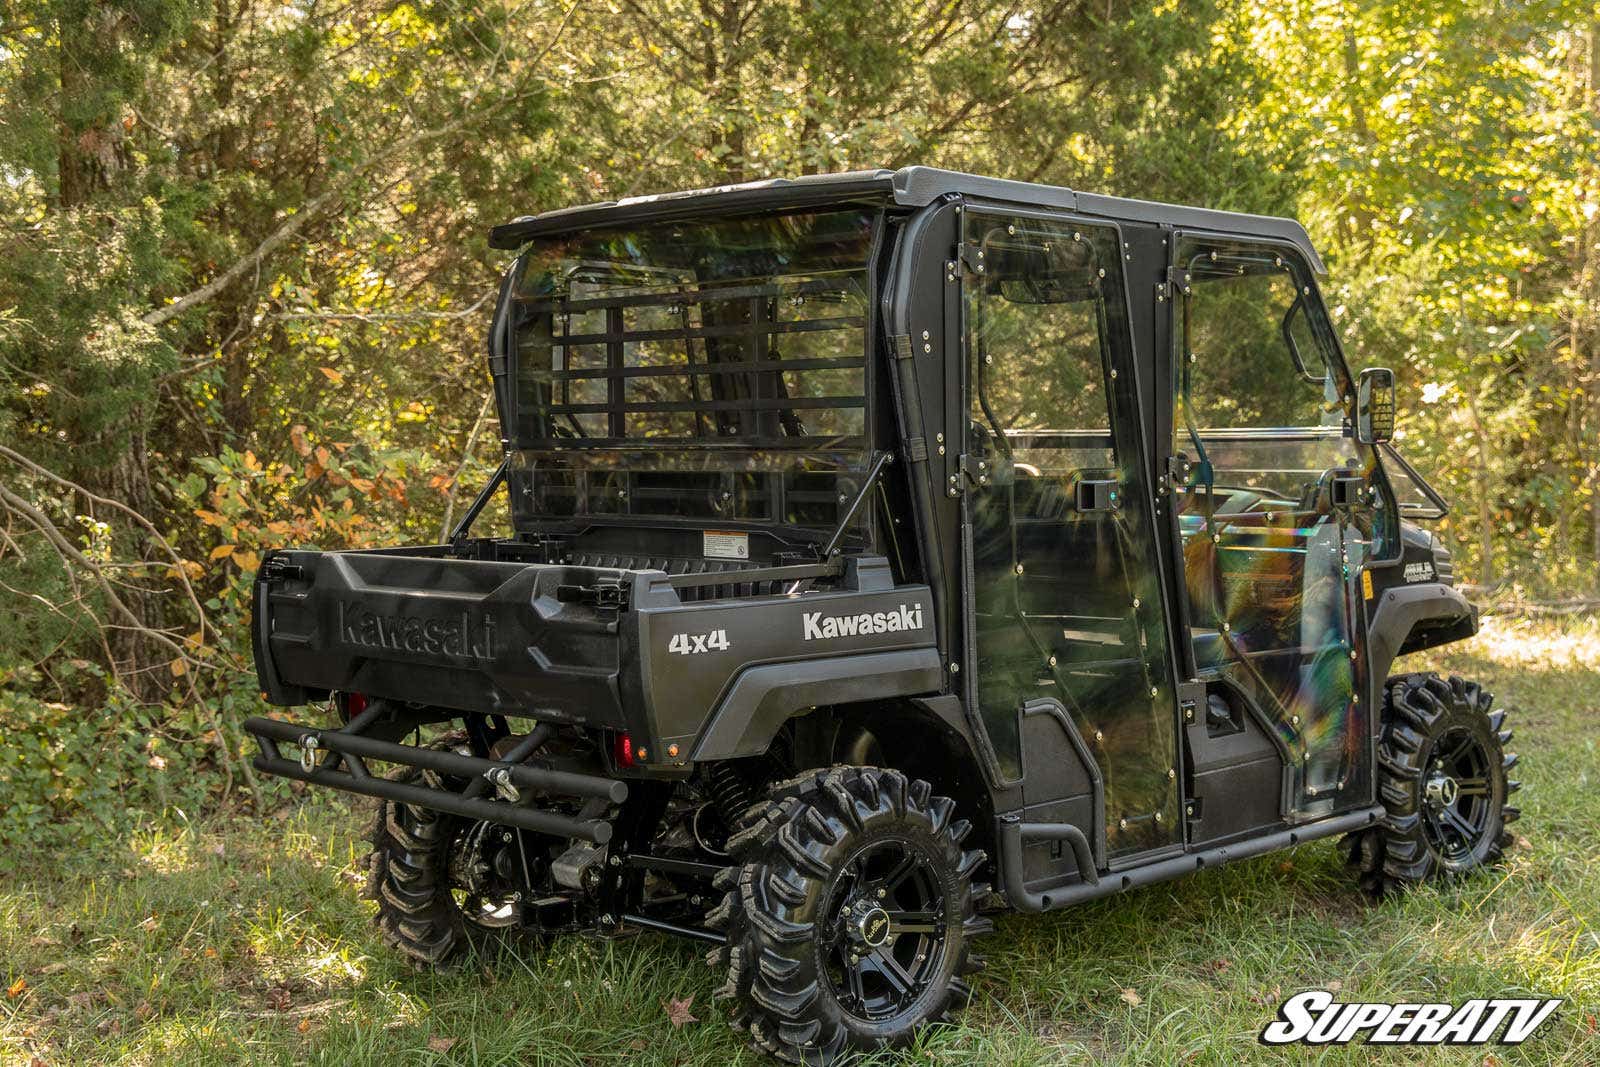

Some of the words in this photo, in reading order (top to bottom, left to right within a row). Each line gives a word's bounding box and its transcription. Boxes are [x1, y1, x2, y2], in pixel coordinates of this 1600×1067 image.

[337, 600, 497, 660] Kawasaki
[803, 603, 923, 640] Kawasaki
[668, 629, 730, 655] 4x4
